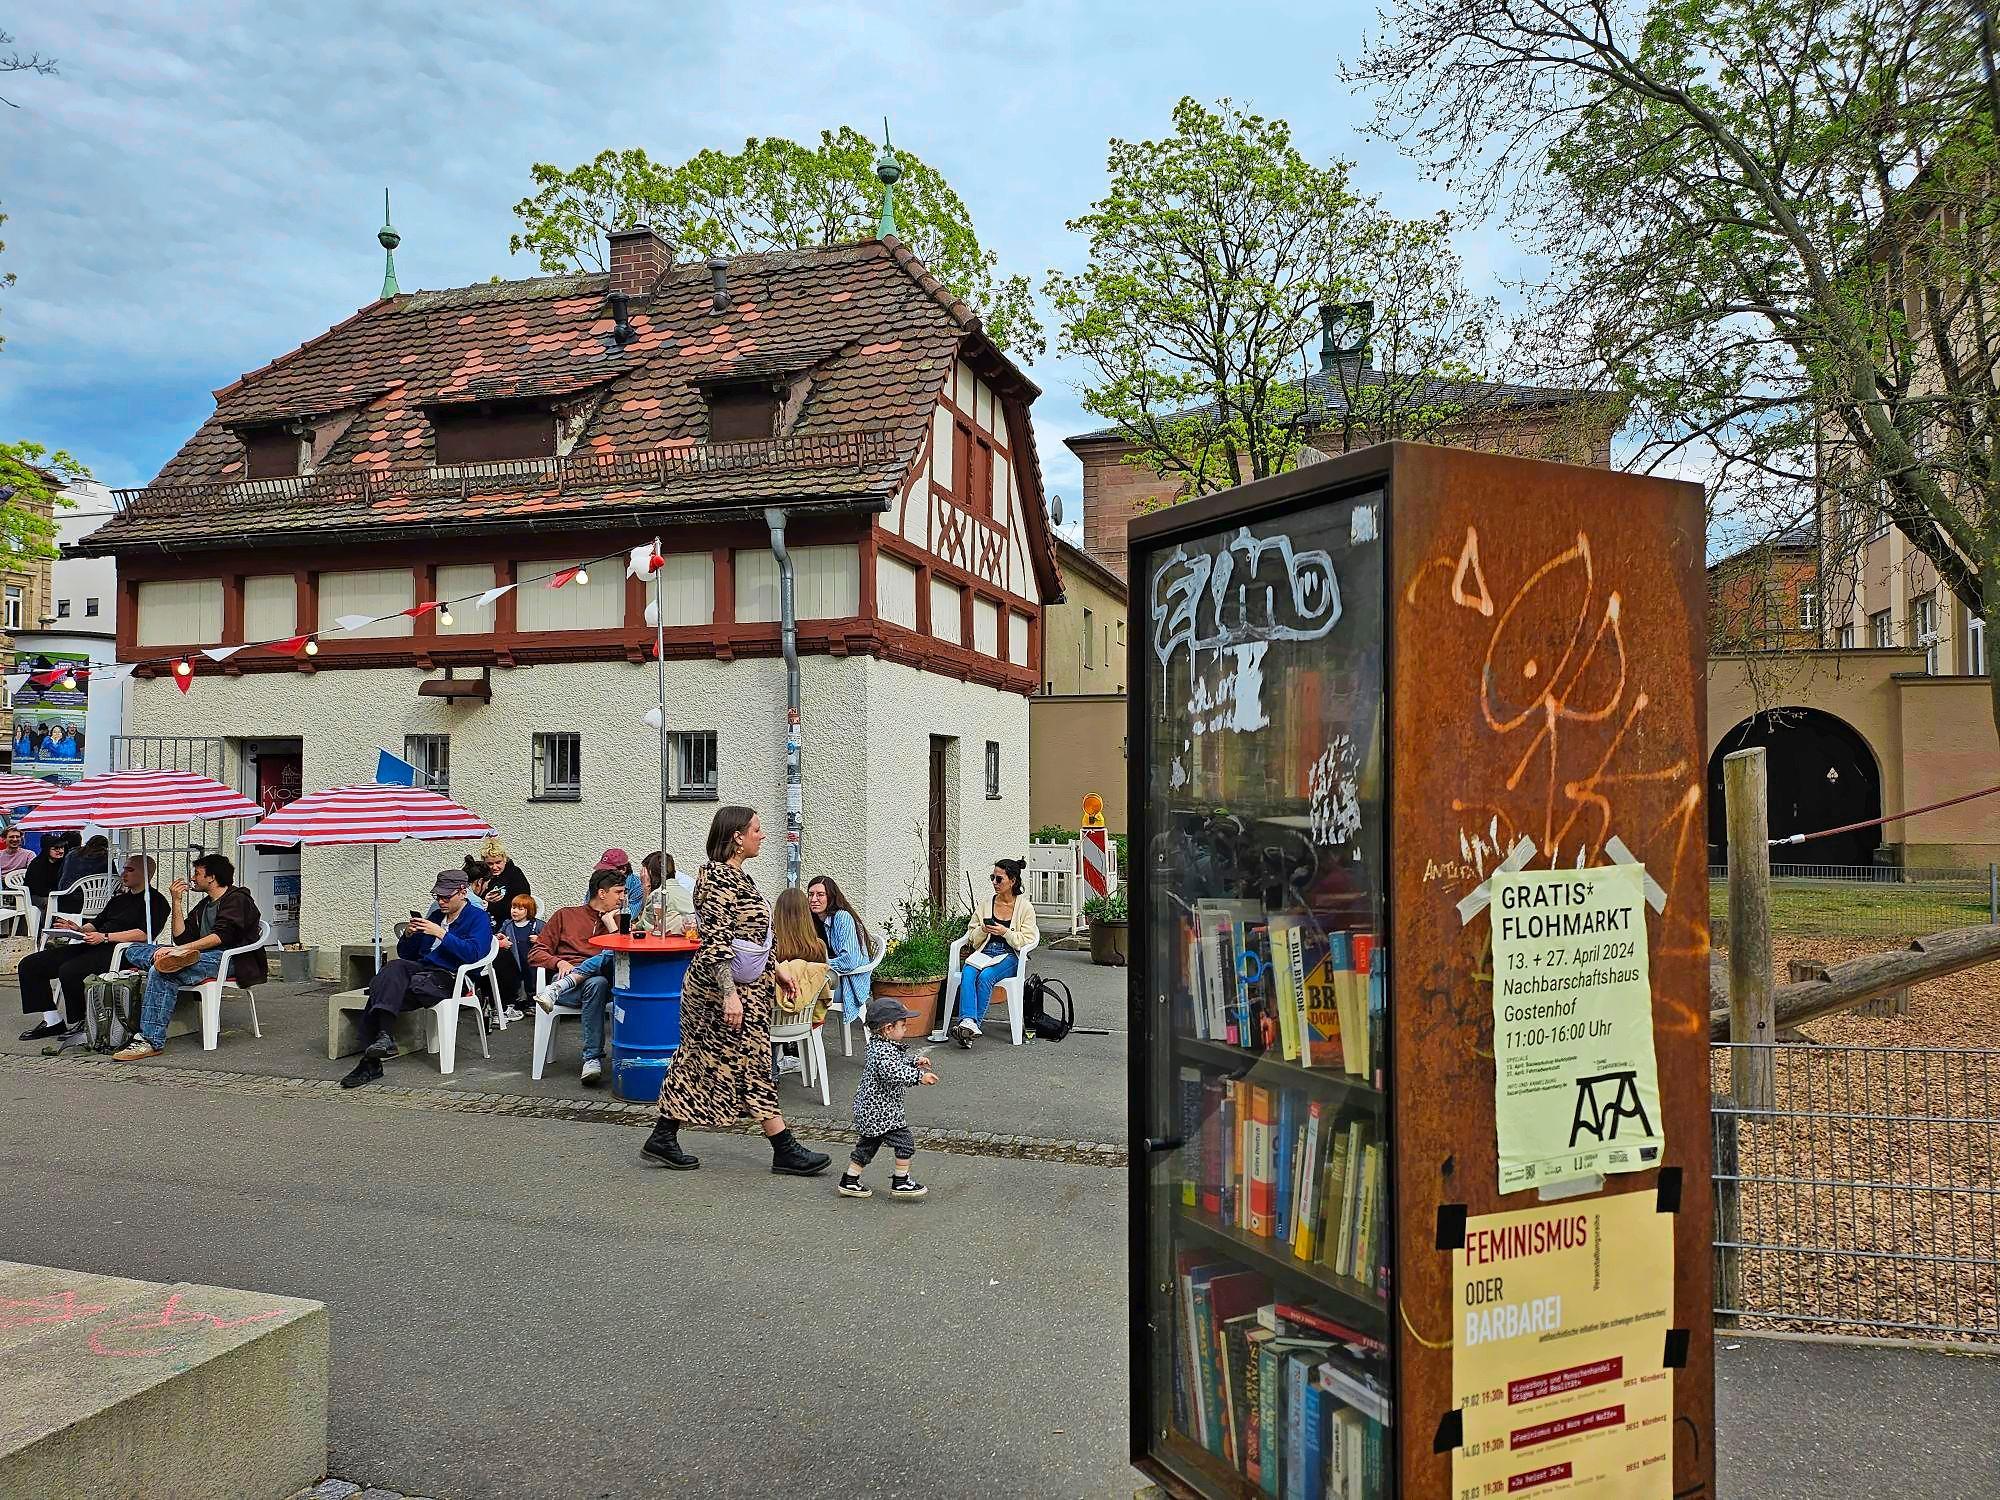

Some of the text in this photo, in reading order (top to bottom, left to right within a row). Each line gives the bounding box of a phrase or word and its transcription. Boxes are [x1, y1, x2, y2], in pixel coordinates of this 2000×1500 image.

[1502, 907, 1632, 940] FLOHMARKT
[1508, 941, 1634, 970] 13. + 27. April 2024
[1291, 942, 1305, 1013] BILL BRYSON
[1503, 967, 1639, 996] Nachbarschaftshaus
[1504, 997, 1577, 1022] Gostenhof
[1506, 1018, 1612, 1048] 11:00-16:00 Uhr
[1466, 1215, 1587, 1267] FEMINISMUS
[1466, 1277, 1503, 1306] ODER
[1465, 1295, 1562, 1346] BARBAREI
